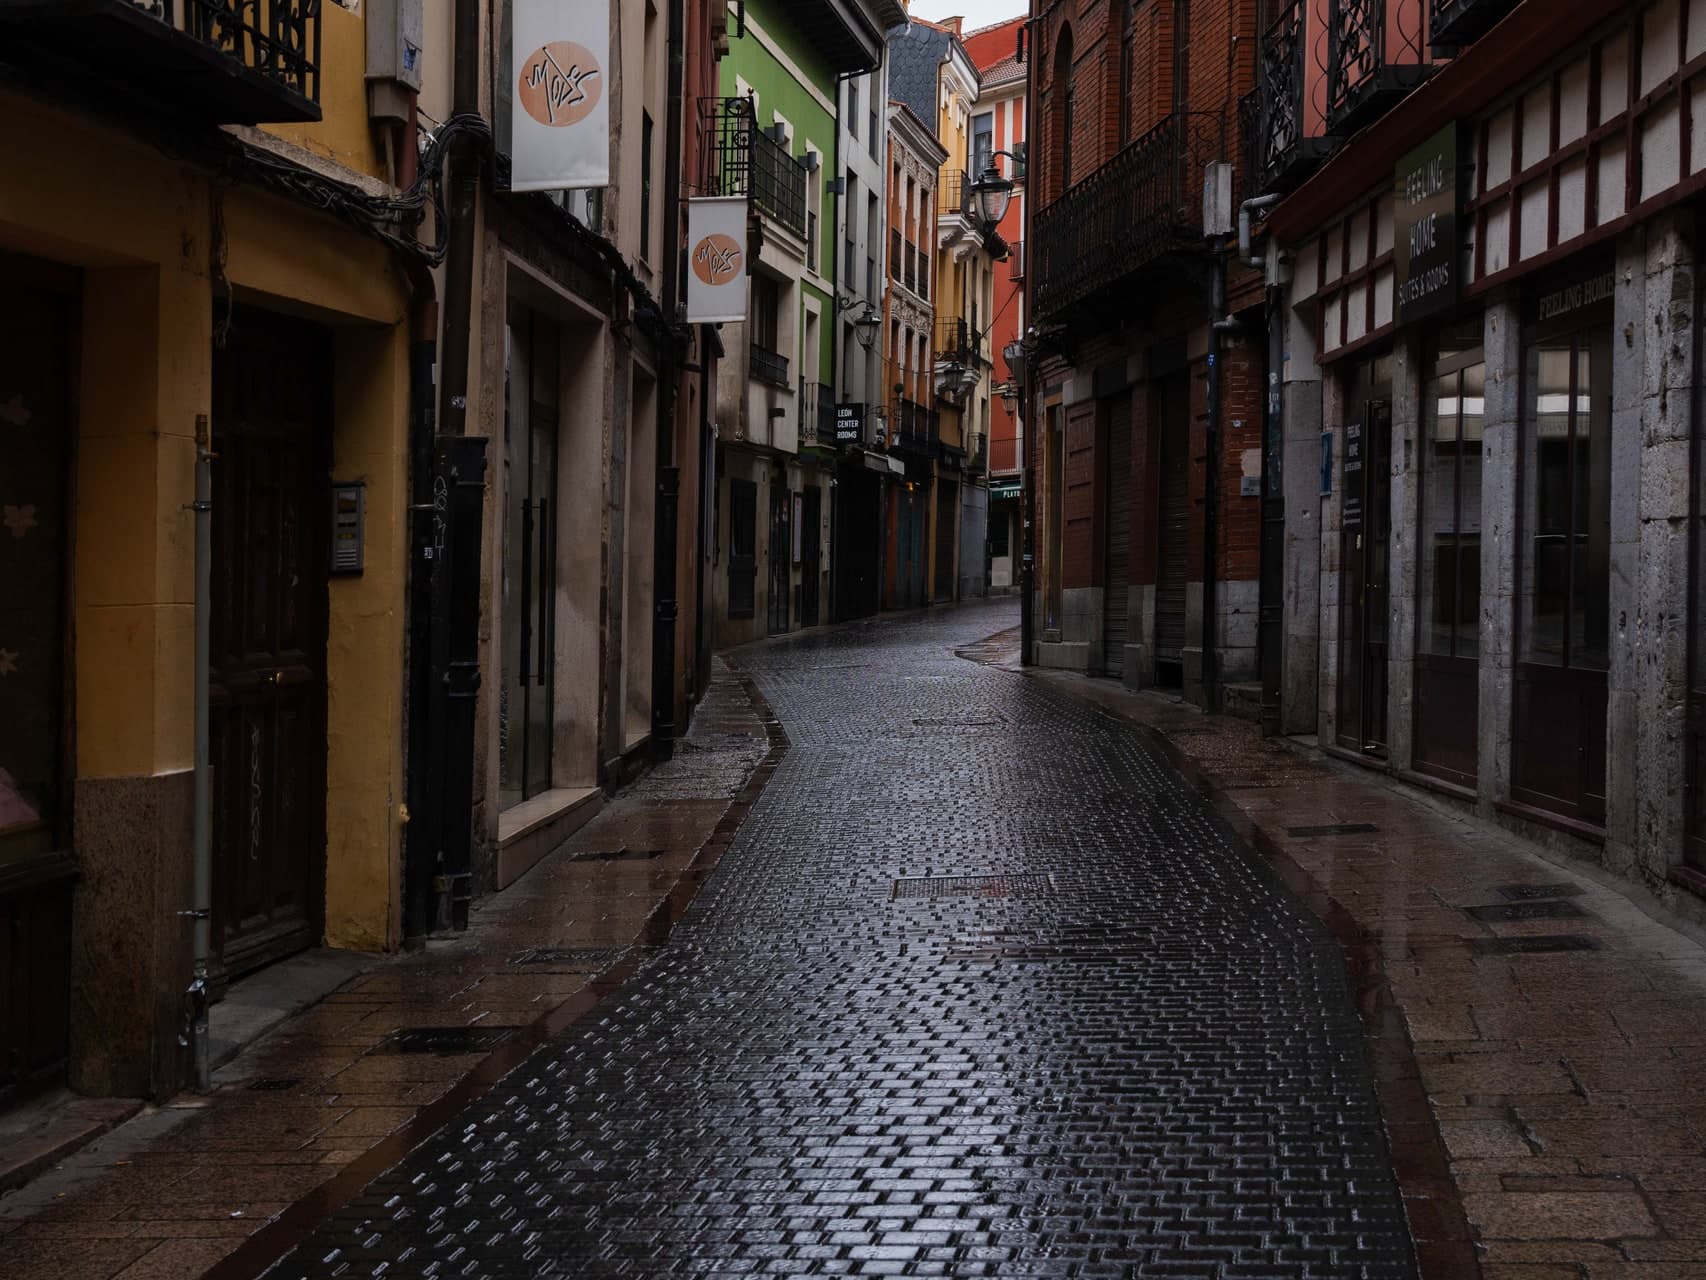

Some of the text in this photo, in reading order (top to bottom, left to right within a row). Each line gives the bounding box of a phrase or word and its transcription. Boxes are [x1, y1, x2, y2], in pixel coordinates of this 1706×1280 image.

[1407, 153, 1443, 208] FEELING
[1410, 211, 1437, 259] HOME
[1399, 277, 1420, 306] SUITES
[1426, 261, 1449, 293] ROOMS
[1539, 282, 1582, 321] FEELING
[837, 419, 859, 428] CENTER
[837, 431, 857, 439] ROOMS
